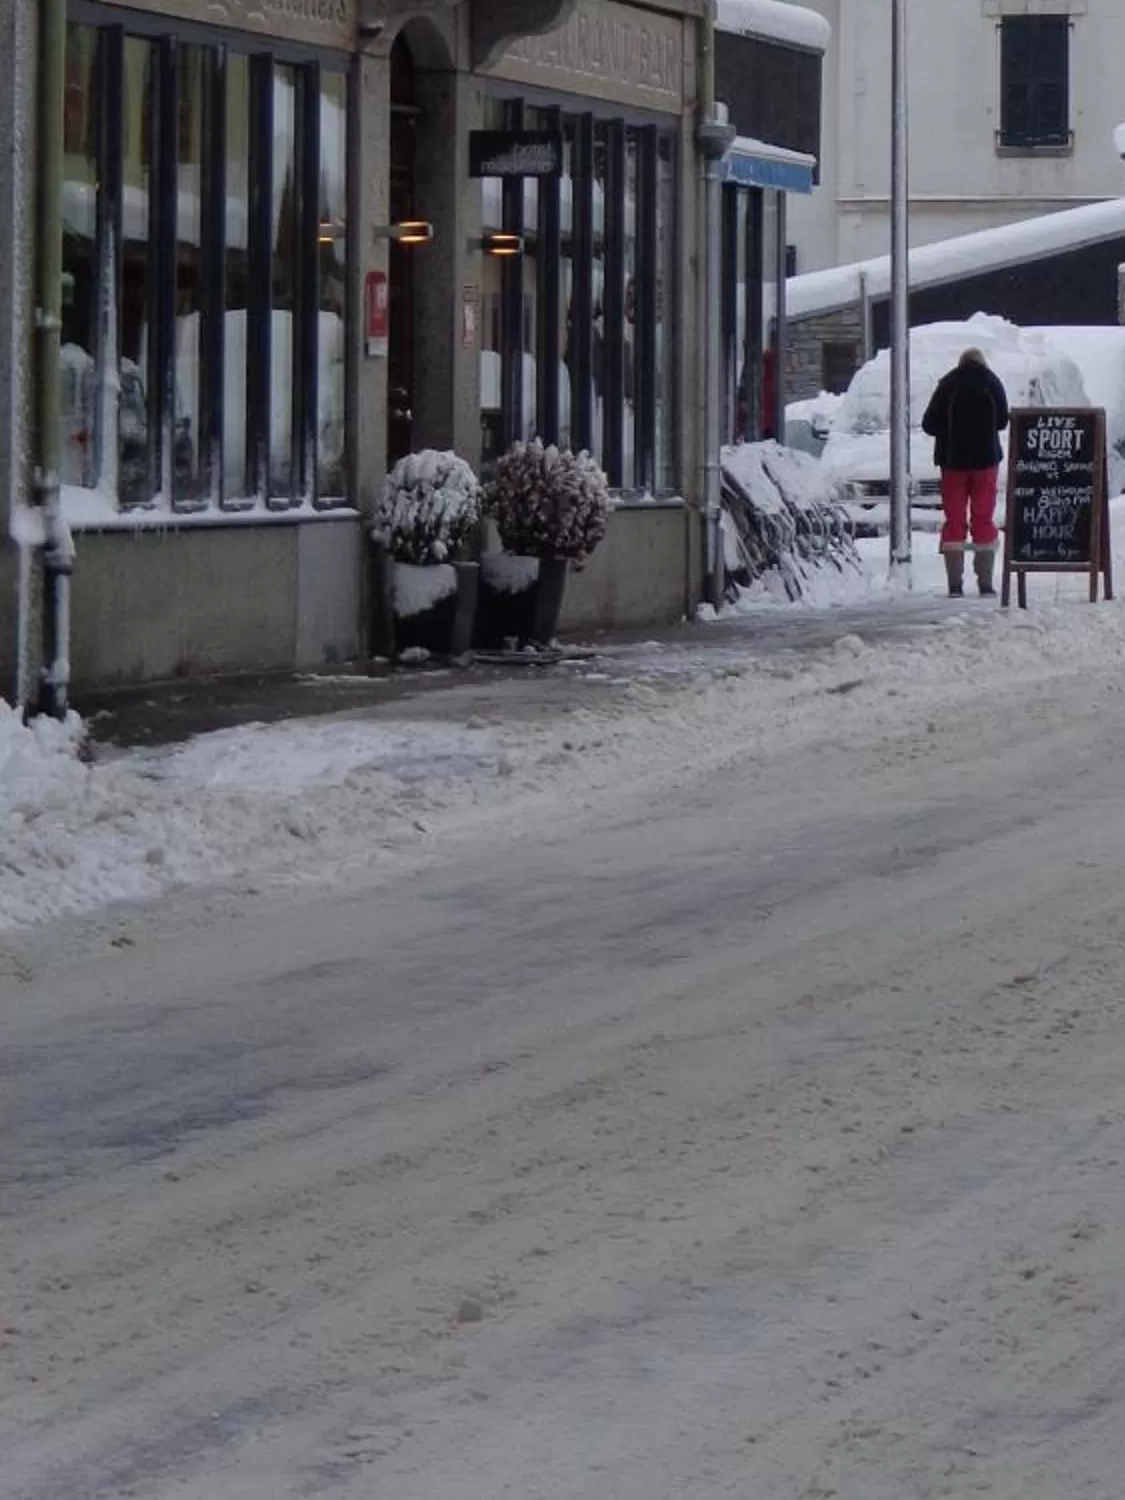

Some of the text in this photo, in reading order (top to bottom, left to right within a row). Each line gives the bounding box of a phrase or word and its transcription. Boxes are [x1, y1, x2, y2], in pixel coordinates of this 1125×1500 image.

[1037, 416, 1077, 429] LIVE
[1026, 428, 1085, 450] SPORT
[1032, 524, 1075, 540] HOUR
